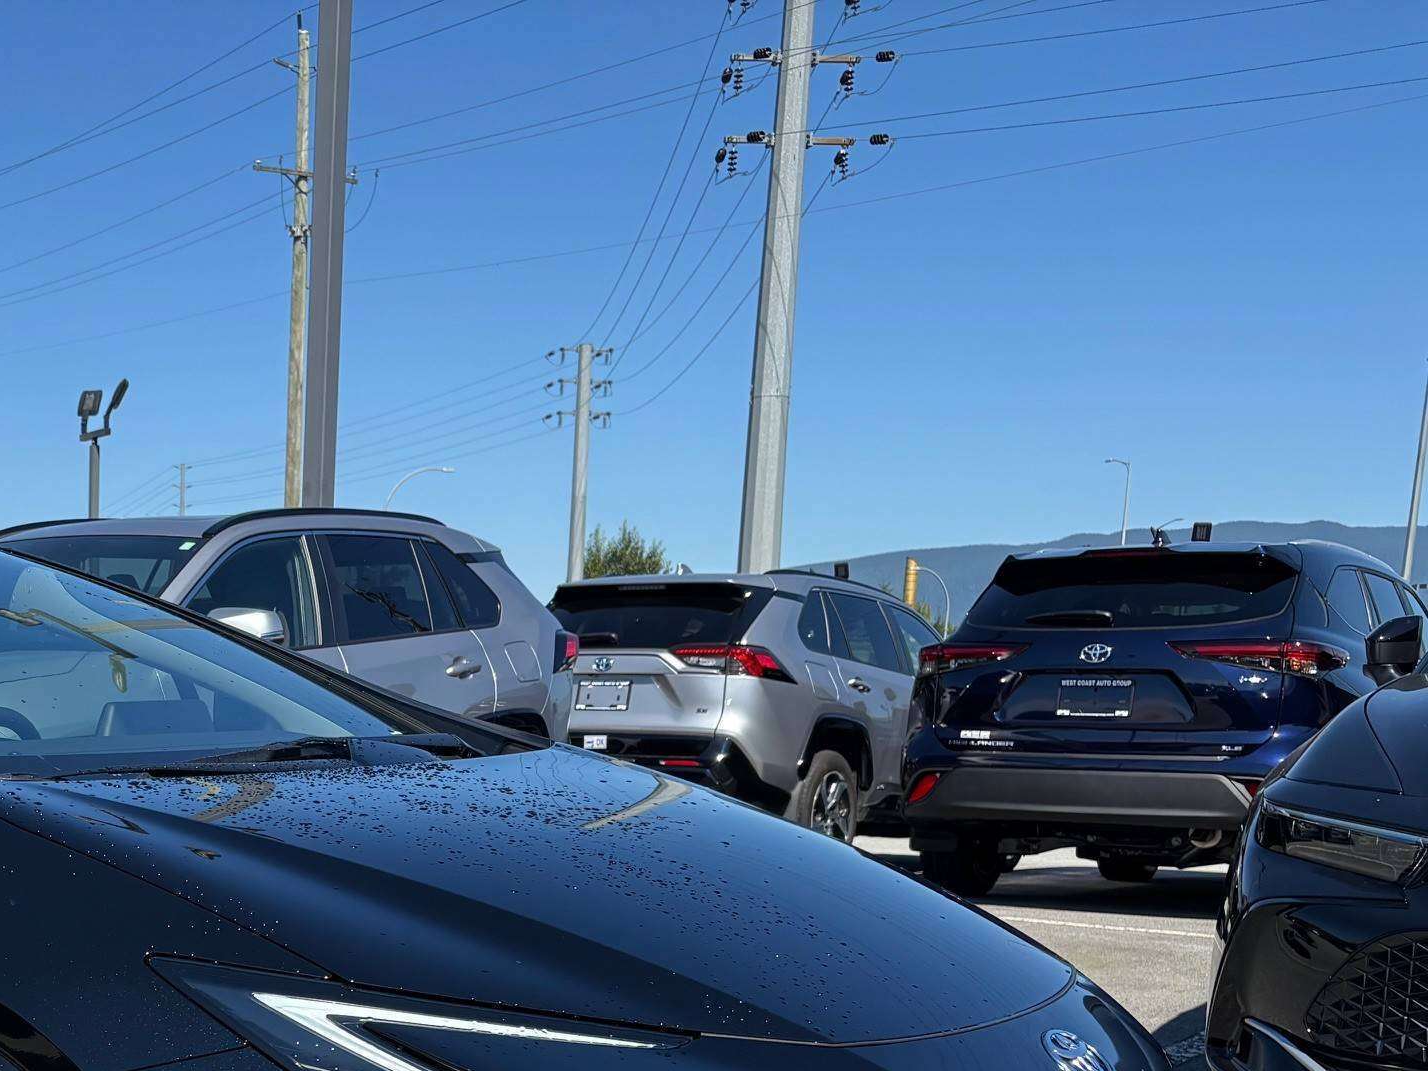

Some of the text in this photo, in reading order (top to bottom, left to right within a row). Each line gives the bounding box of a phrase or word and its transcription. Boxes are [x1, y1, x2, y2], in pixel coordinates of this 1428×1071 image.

[1061, 679, 1132, 687] WEST COAST AUTO GROUP
